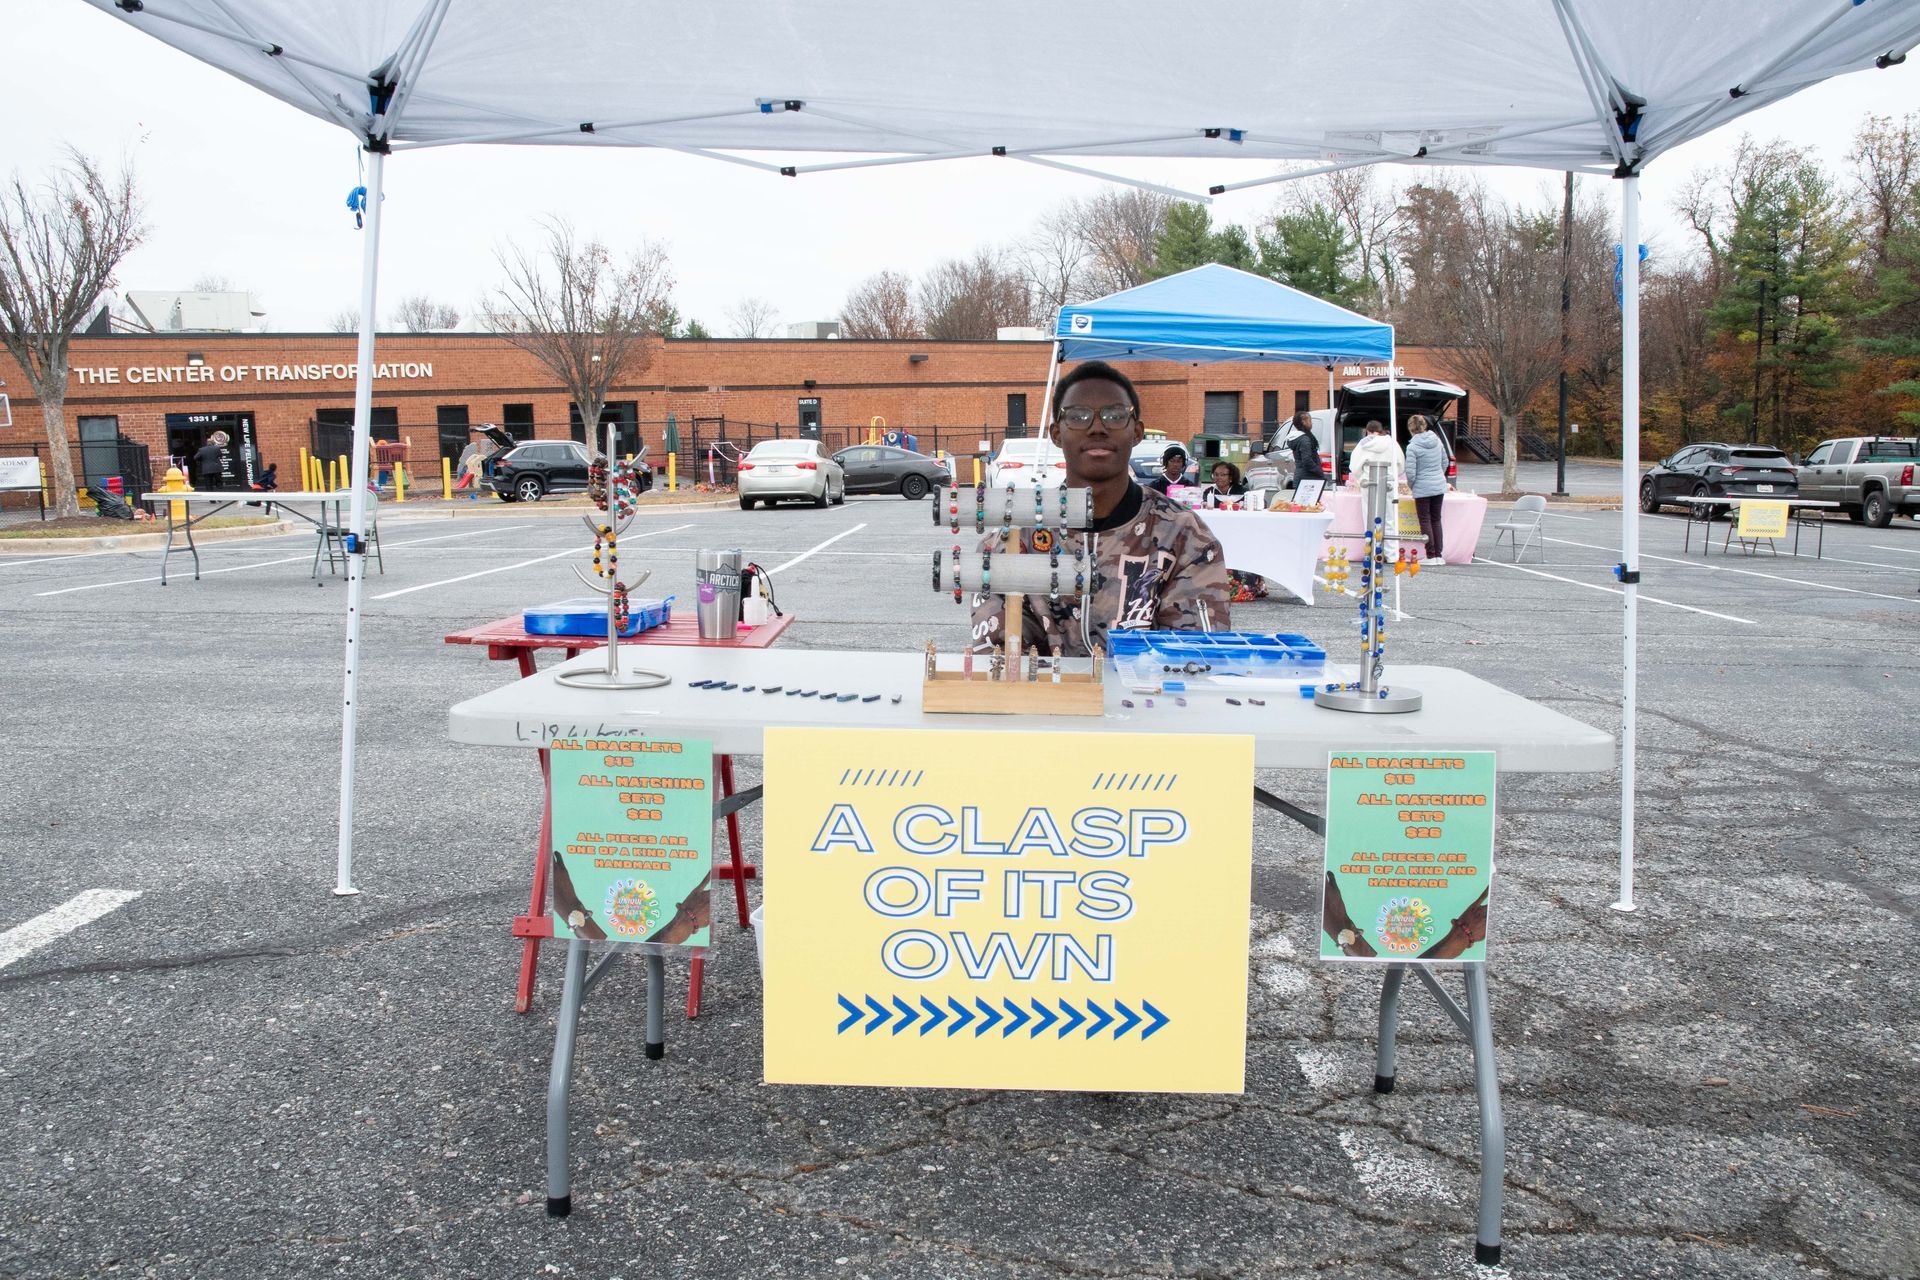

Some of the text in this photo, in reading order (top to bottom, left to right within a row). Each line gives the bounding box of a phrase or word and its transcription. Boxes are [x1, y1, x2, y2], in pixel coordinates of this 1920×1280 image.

[74, 363, 432, 384] THE CENTER OF TRANSFORATION
[1343, 366, 1404, 376] AMA TRAINNG
[551, 740, 682, 752] ALL BRACELETS
[604, 756, 634, 767] $15
[1330, 758, 1465, 769] ALL BRACELETS
[578, 775, 704, 790] ALL MATCHING
[1384, 774, 1415, 785] $15
[619, 792, 666, 804] SETS
[1357, 794, 1486, 806] ALL MATCHING
[1398, 811, 1445, 822] SETS
[811, 804, 1190, 858] A CLASP
[576, 832, 688, 846] ALL PIECES ARE
[567, 846, 698, 859] ONE OF A KIND AND
[1352, 853, 1467, 863] ALL PIECES ARE
[594, 859, 671, 870] HANDMADE
[1340, 865, 1477, 876] ONE OF A KIND AND
[1368, 878, 1448, 888] HANDMADE
[862, 866, 1136, 921] OF ITS
[880, 929, 1116, 982] OWN
